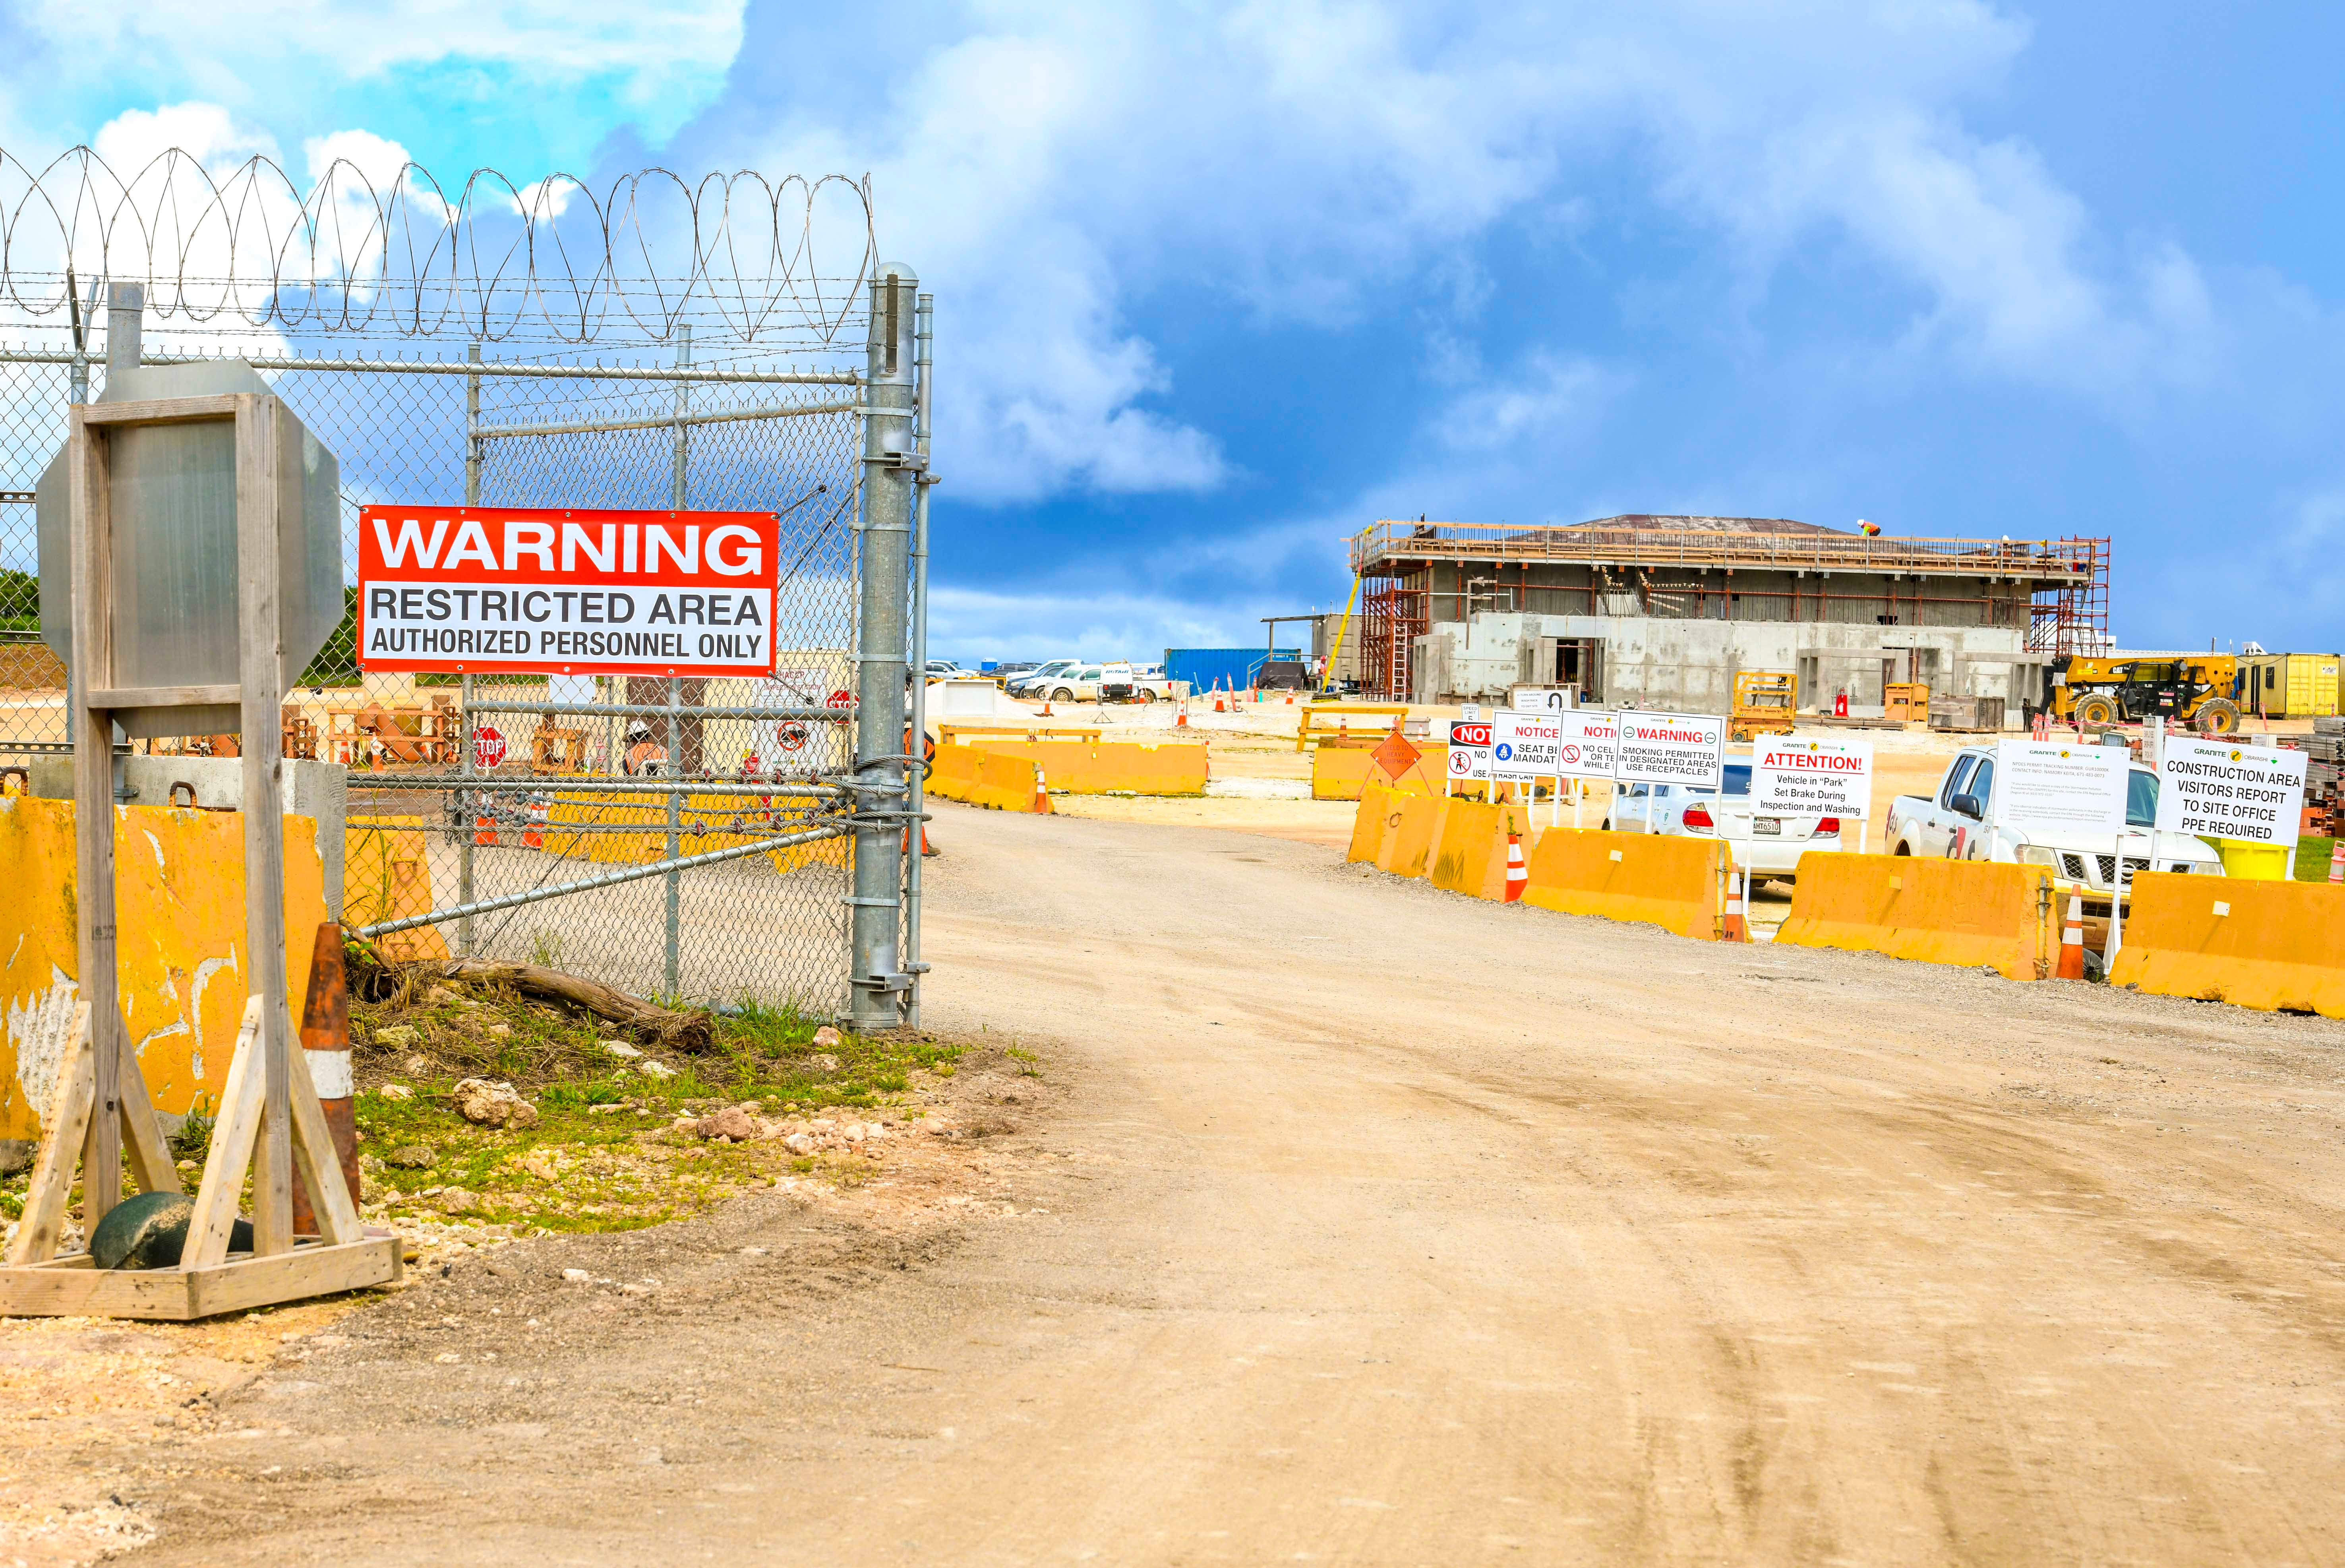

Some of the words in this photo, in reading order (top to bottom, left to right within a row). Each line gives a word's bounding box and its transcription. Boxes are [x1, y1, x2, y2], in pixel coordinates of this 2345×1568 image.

[372, 519, 762, 576] WARNING
[371, 588, 635, 623] RESTRICTED
[648, 593, 762, 626] AREA
[371, 628, 531, 654] AUTHORIZED
[540, 630, 689, 657] PERSONNEL
[698, 633, 761, 659] ONLY
[1515, 726, 1559, 738] NOTICE
[1584, 726, 1616, 738] NOTI
[1636, 728, 1703, 743] WARNING
[473, 739, 504, 755] TOP
[1519, 744, 1544, 754] SEAT
[1622, 746, 1662, 756] SMOKING
[1665, 750, 1714, 760] PERMITTED
[2194, 748, 2226, 757] GRANITE
[1474, 750, 1487, 759] NO
[1630, 755, 1685, 766] DESIGNATED
[1687, 760, 1716, 768] AREAS
[1764, 752, 1862, 770] ATTENTION!
[1584, 760, 1610, 769] WHILE
[1646, 765, 1708, 776] RECEPTACLES
[1473, 769, 1486, 777] USE
[1777, 775, 1807, 785] Vehicle
[1810, 777, 1817, 785] in
[2167, 760, 2265, 783] CONSTRUCTION
[2268, 773, 2300, 788] AREA
[1774, 788, 1788, 797] Set
[1791, 789, 1815, 799] Brake
[1818, 790, 1846, 802] During
[2178, 780, 2233, 798] VISITORS
[2236, 787, 2287, 804] REPORT
[1760, 800, 1804, 811] Inspection
[1806, 804, 1822, 812] and
[1825, 804, 1861, 816] Washing
[2183, 799, 2199, 812] TO
[2202, 802, 2229, 816] SITE
[2233, 805, 2276, 822] OFFICE
[2182, 818, 2206, 831] PPE
[2209, 821, 2272, 839] REQUIRED
